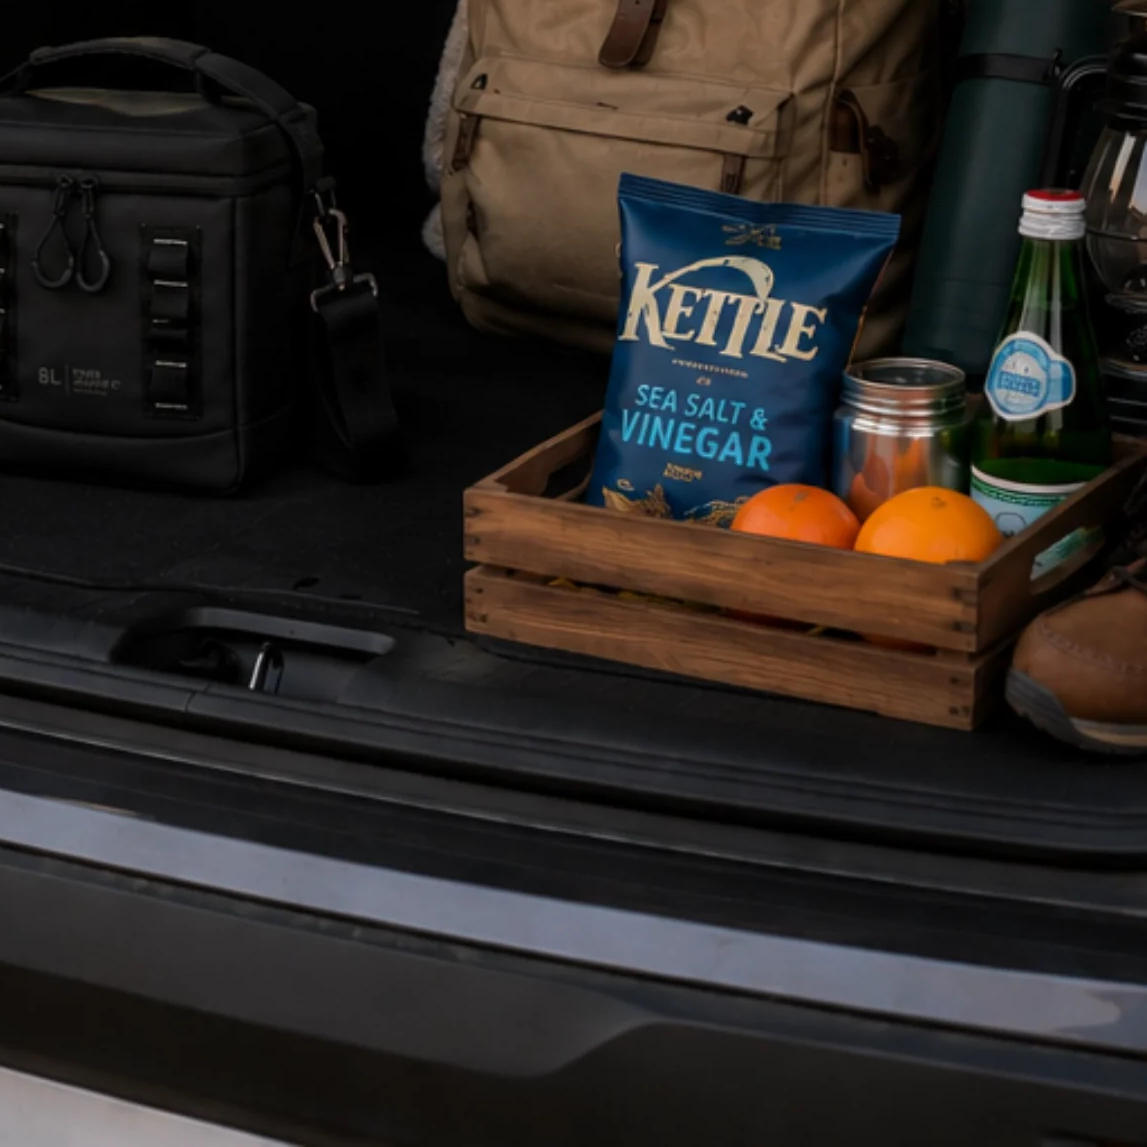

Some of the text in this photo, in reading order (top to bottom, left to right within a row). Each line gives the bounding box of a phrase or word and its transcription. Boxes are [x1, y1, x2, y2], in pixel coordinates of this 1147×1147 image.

[618, 255, 827, 363] KETTLE
[38, 366, 62, 386] 8L
[635, 383, 769, 432] SEA SALT &
[621, 409, 772, 471] VINEGAR
